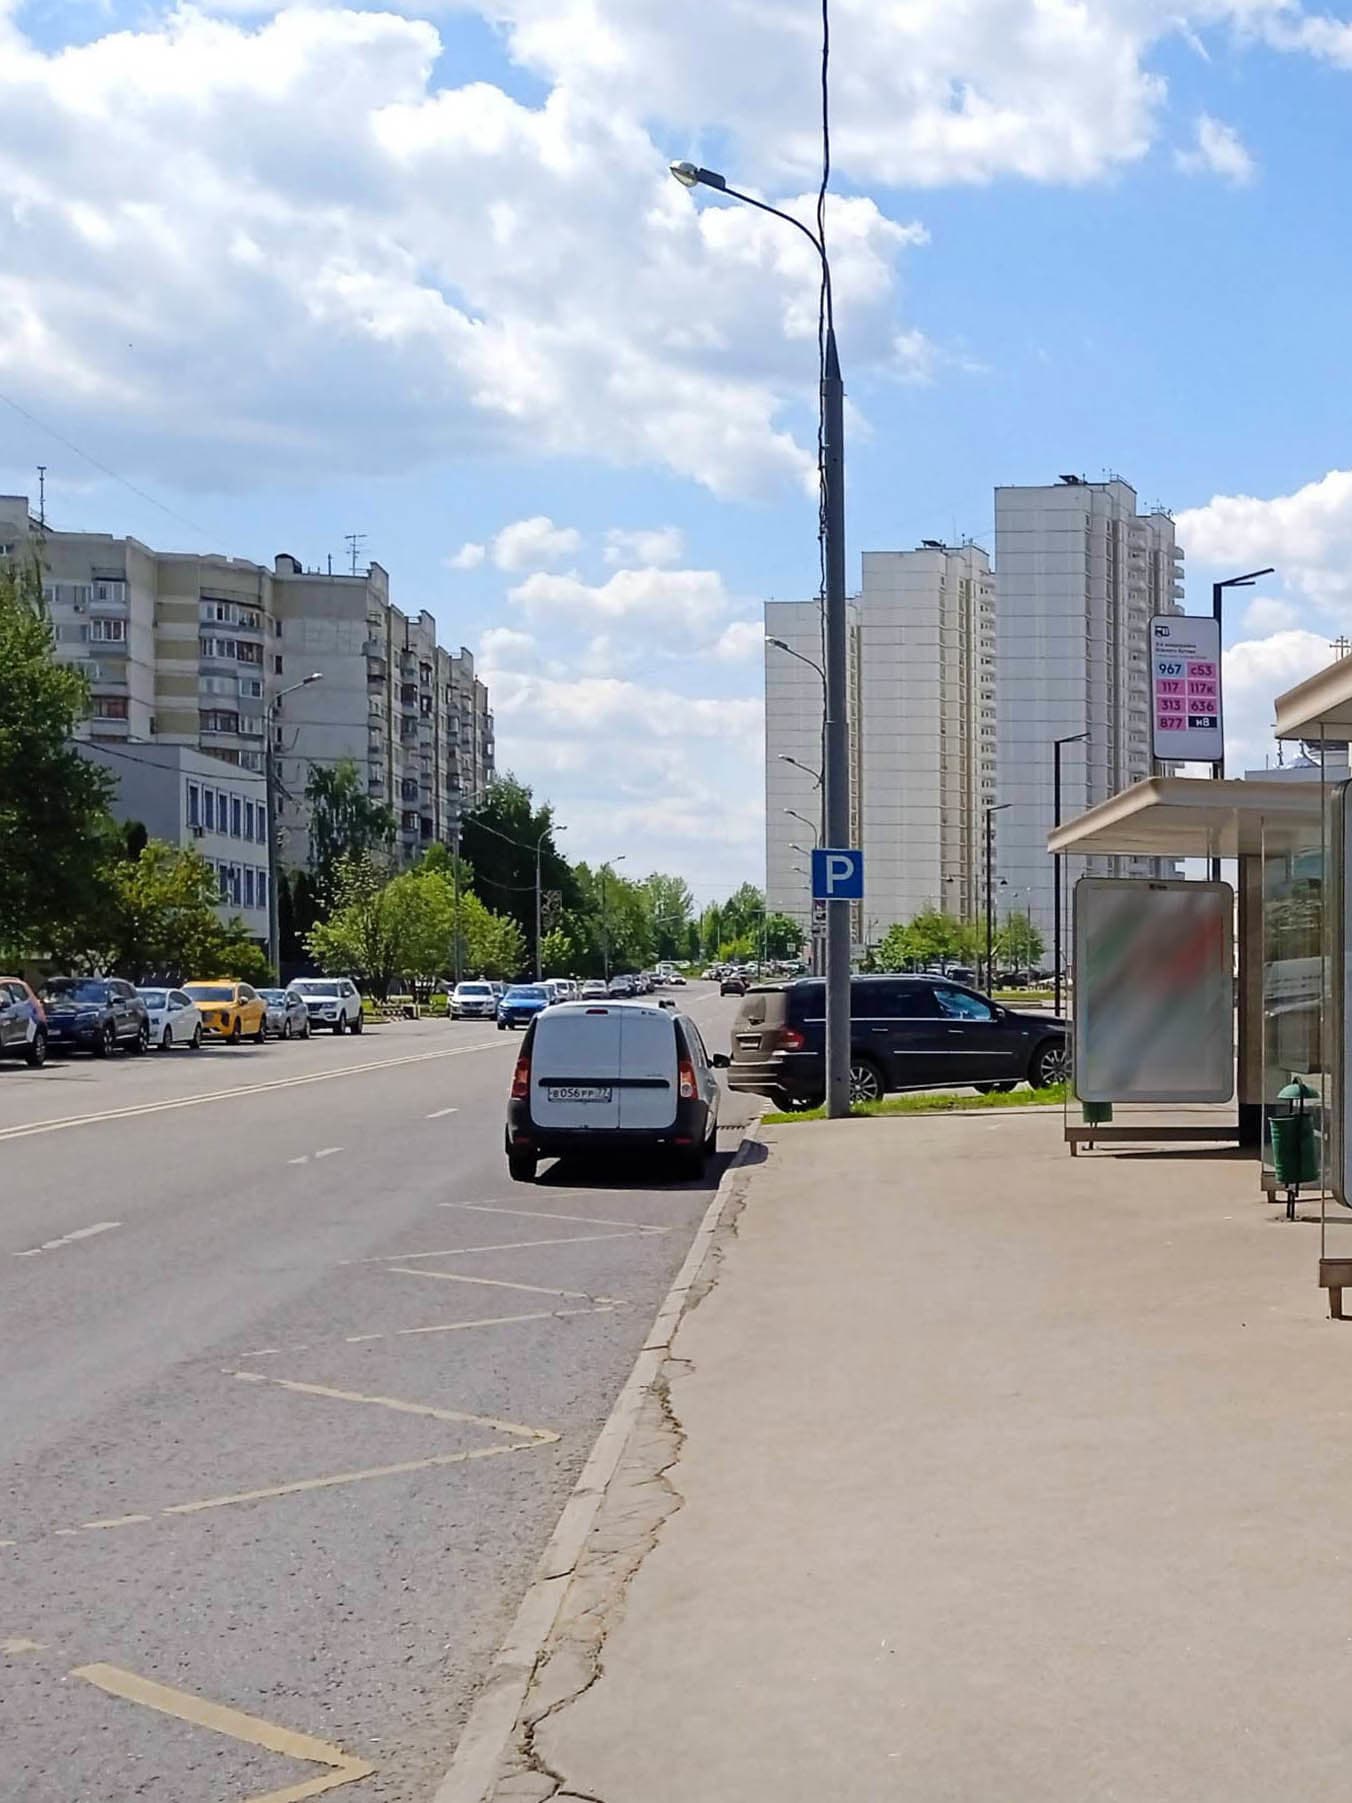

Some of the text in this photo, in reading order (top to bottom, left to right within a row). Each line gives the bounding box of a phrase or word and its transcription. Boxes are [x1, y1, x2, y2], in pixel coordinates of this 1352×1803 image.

[1159, 664, 1181, 675] 967
[1162, 682, 1179, 692] 117
[1161, 700, 1214, 712] 313 636
[1160, 718, 1183, 729] 877
